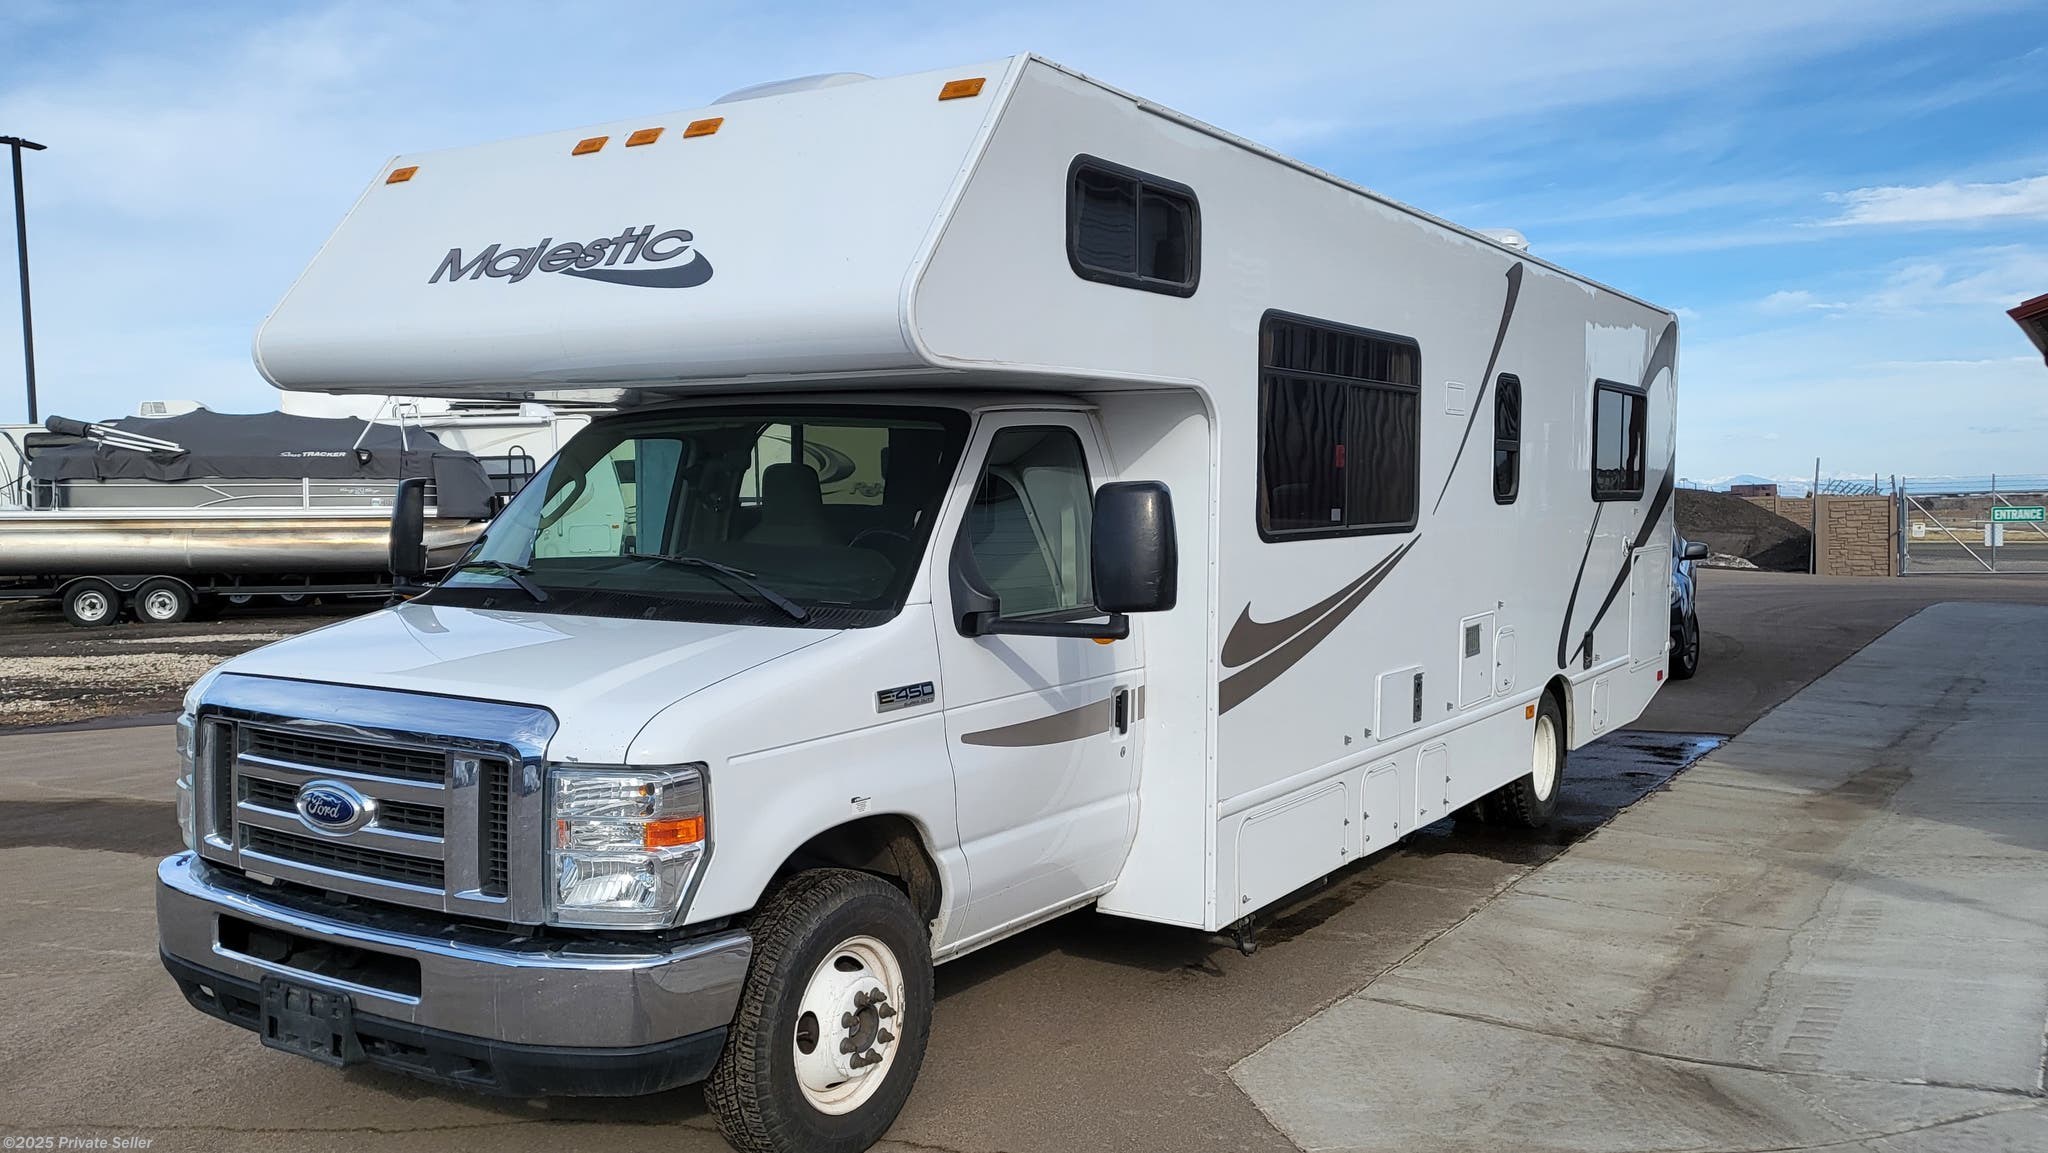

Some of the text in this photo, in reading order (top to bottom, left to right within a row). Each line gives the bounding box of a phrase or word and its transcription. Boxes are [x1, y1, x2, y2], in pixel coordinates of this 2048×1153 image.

[428, 224, 693, 284] Majestic
[1994, 509, 2043, 520] ENTRANCE
[304, 795, 341, 818] Ford
